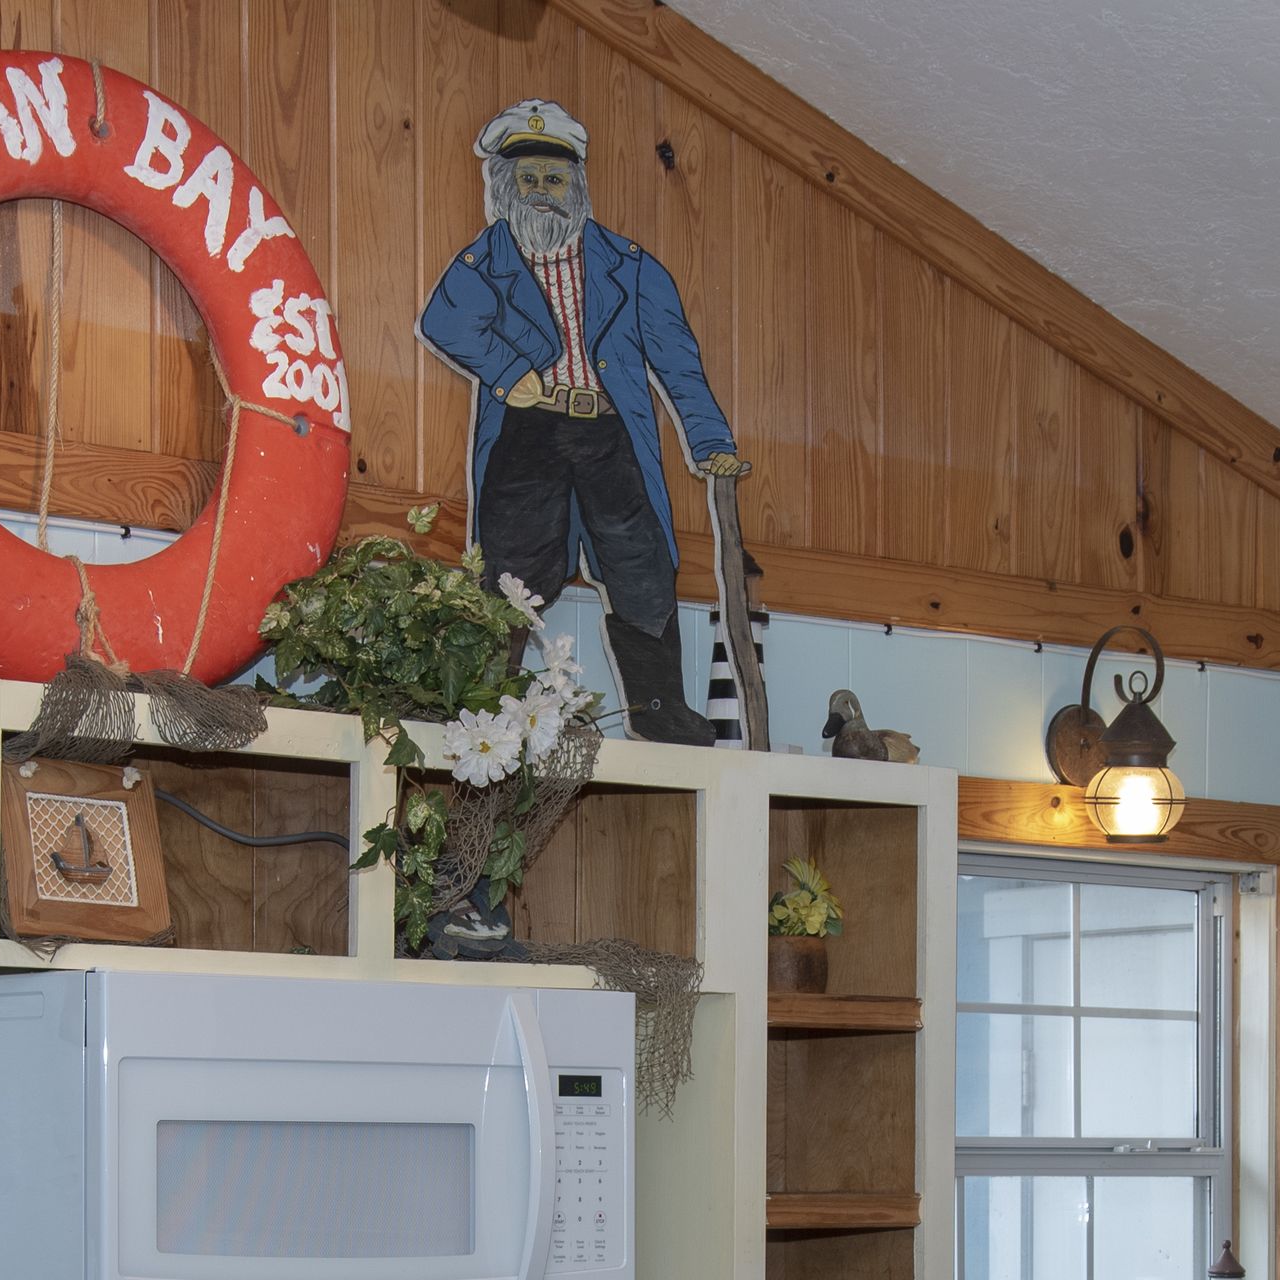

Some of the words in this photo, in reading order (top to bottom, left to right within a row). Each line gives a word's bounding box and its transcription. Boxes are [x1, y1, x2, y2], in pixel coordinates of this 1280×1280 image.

[123, 89, 295, 273] BAY
[250, 279, 338, 359] EST
[263, 351, 351, 431] 2001
[574, 1082, 597, 1094] 5:49
